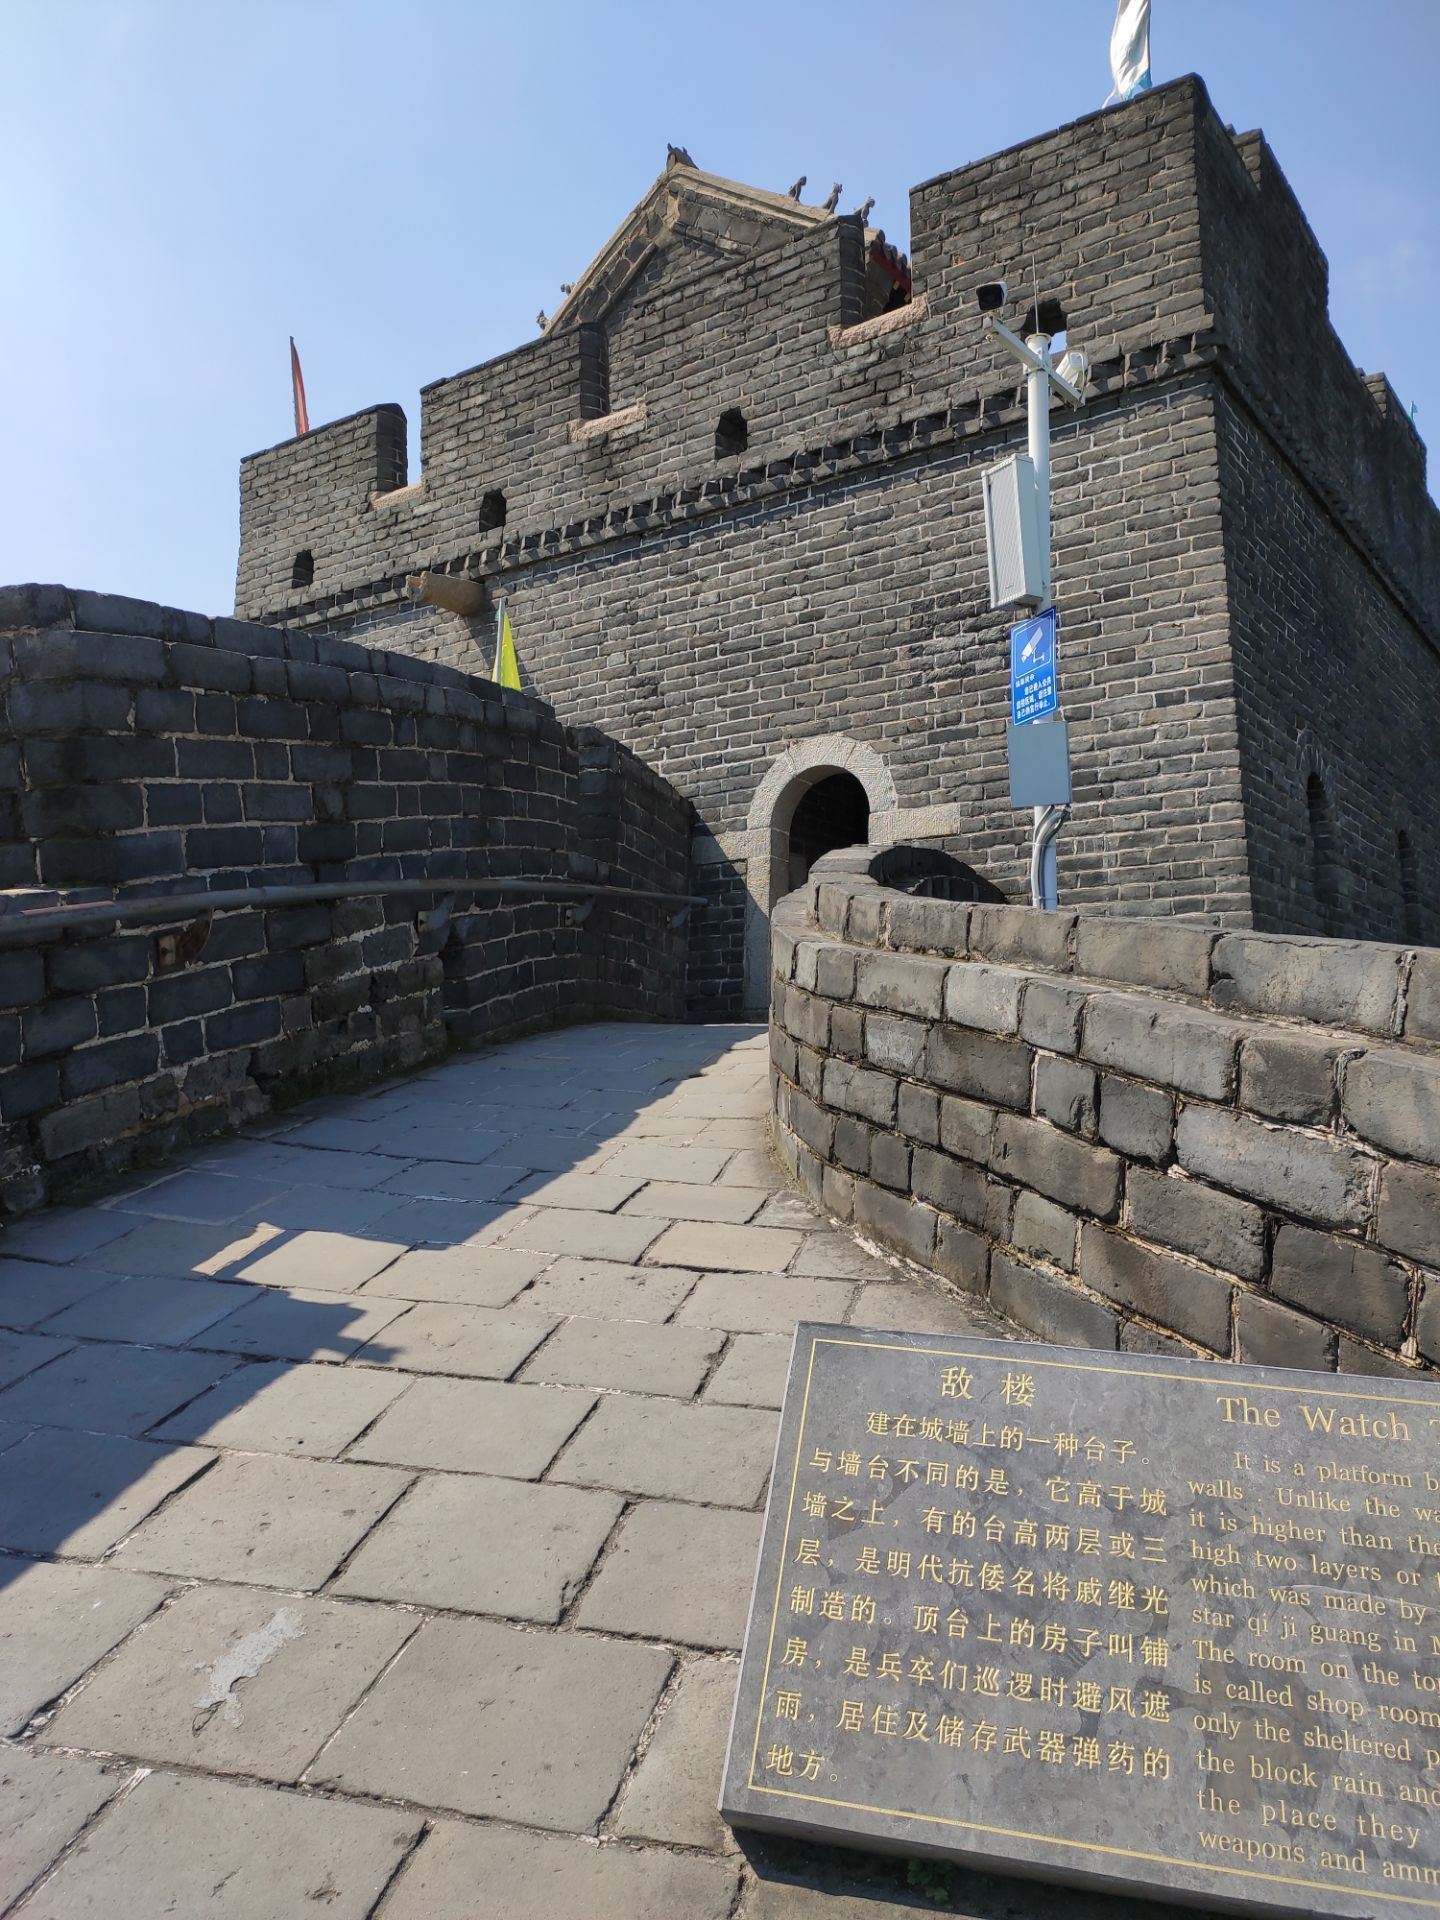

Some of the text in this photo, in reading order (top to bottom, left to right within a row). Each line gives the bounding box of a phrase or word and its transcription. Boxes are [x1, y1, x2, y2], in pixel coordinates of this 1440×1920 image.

[866, 1411, 1150, 1466] 建在城墙上的一种台子。
[1216, 1397, 1412, 1440] The Watch
[808, 1447, 1168, 1518] 与墙台不同的是，它高于城
[1234, 1452, 1251, 1470] It
[1264, 1454, 1281, 1473] is
[1294, 1463, 1305, 1476] a
[1318, 1462, 1412, 1488] platform
[1188, 1479, 1243, 1500] walls
[1276, 1487, 1350, 1512] Unlike
[1365, 1498, 1400, 1518] the
[801, 1491, 1168, 1564] 墙之上，有的台高两层或三
[1189, 1508, 1205, 1527] it
[1219, 1511, 1237, 1531] is
[1251, 1516, 1326, 1542] higher
[1339, 1527, 1393, 1550] than
[793, 1538, 1169, 1615] 层，是明代抗倭名将戚继光
[1191, 1539, 1241, 1566] high
[1256, 1550, 1297, 1571] two
[1310, 1554, 1381, 1581] layers
[1397, 1570, 1420, 1586] or
[1191, 1574, 1426, 1625] which was made by
[790, 1585, 1169, 1668] 制造的。顶台上的房子叫铺
[1192, 1608, 1234, 1628] star
[1248, 1613, 1269, 1636] qi
[1281, 1616, 1297, 1640] ji
[1310, 1624, 1381, 1652] guang
[1394, 1629, 1417, 1652] in
[780, 1638, 1170, 1723] 房，是兵卒们巡逻时避风遮
[1192, 1639, 1235, 1664] The
[1249, 1652, 1308, 1674] room
[1321, 1661, 1349, 1679] on
[1362, 1662, 1400, 1686] the
[1194, 1673, 1212, 1695] is
[1226, 1680, 1294, 1707] called
[1308, 1690, 1364, 1721] shop
[775, 1690, 1171, 1781] 雨，居住及储存武器弹药的
[1194, 1712, 1241, 1740] only
[1254, 1718, 1290, 1742] the
[1304, 1725, 1412, 1761] sheltered
[767, 1743, 838, 1782] 地方。
[1196, 1750, 1235, 1774] the
[1249, 1755, 1318, 1788] block
[1332, 1771, 1383, 1797] rain
[1197, 1789, 1420, 1848] the place they
[1199, 1832, 1305, 1863] weapons
[1321, 1850, 1367, 1874] and
